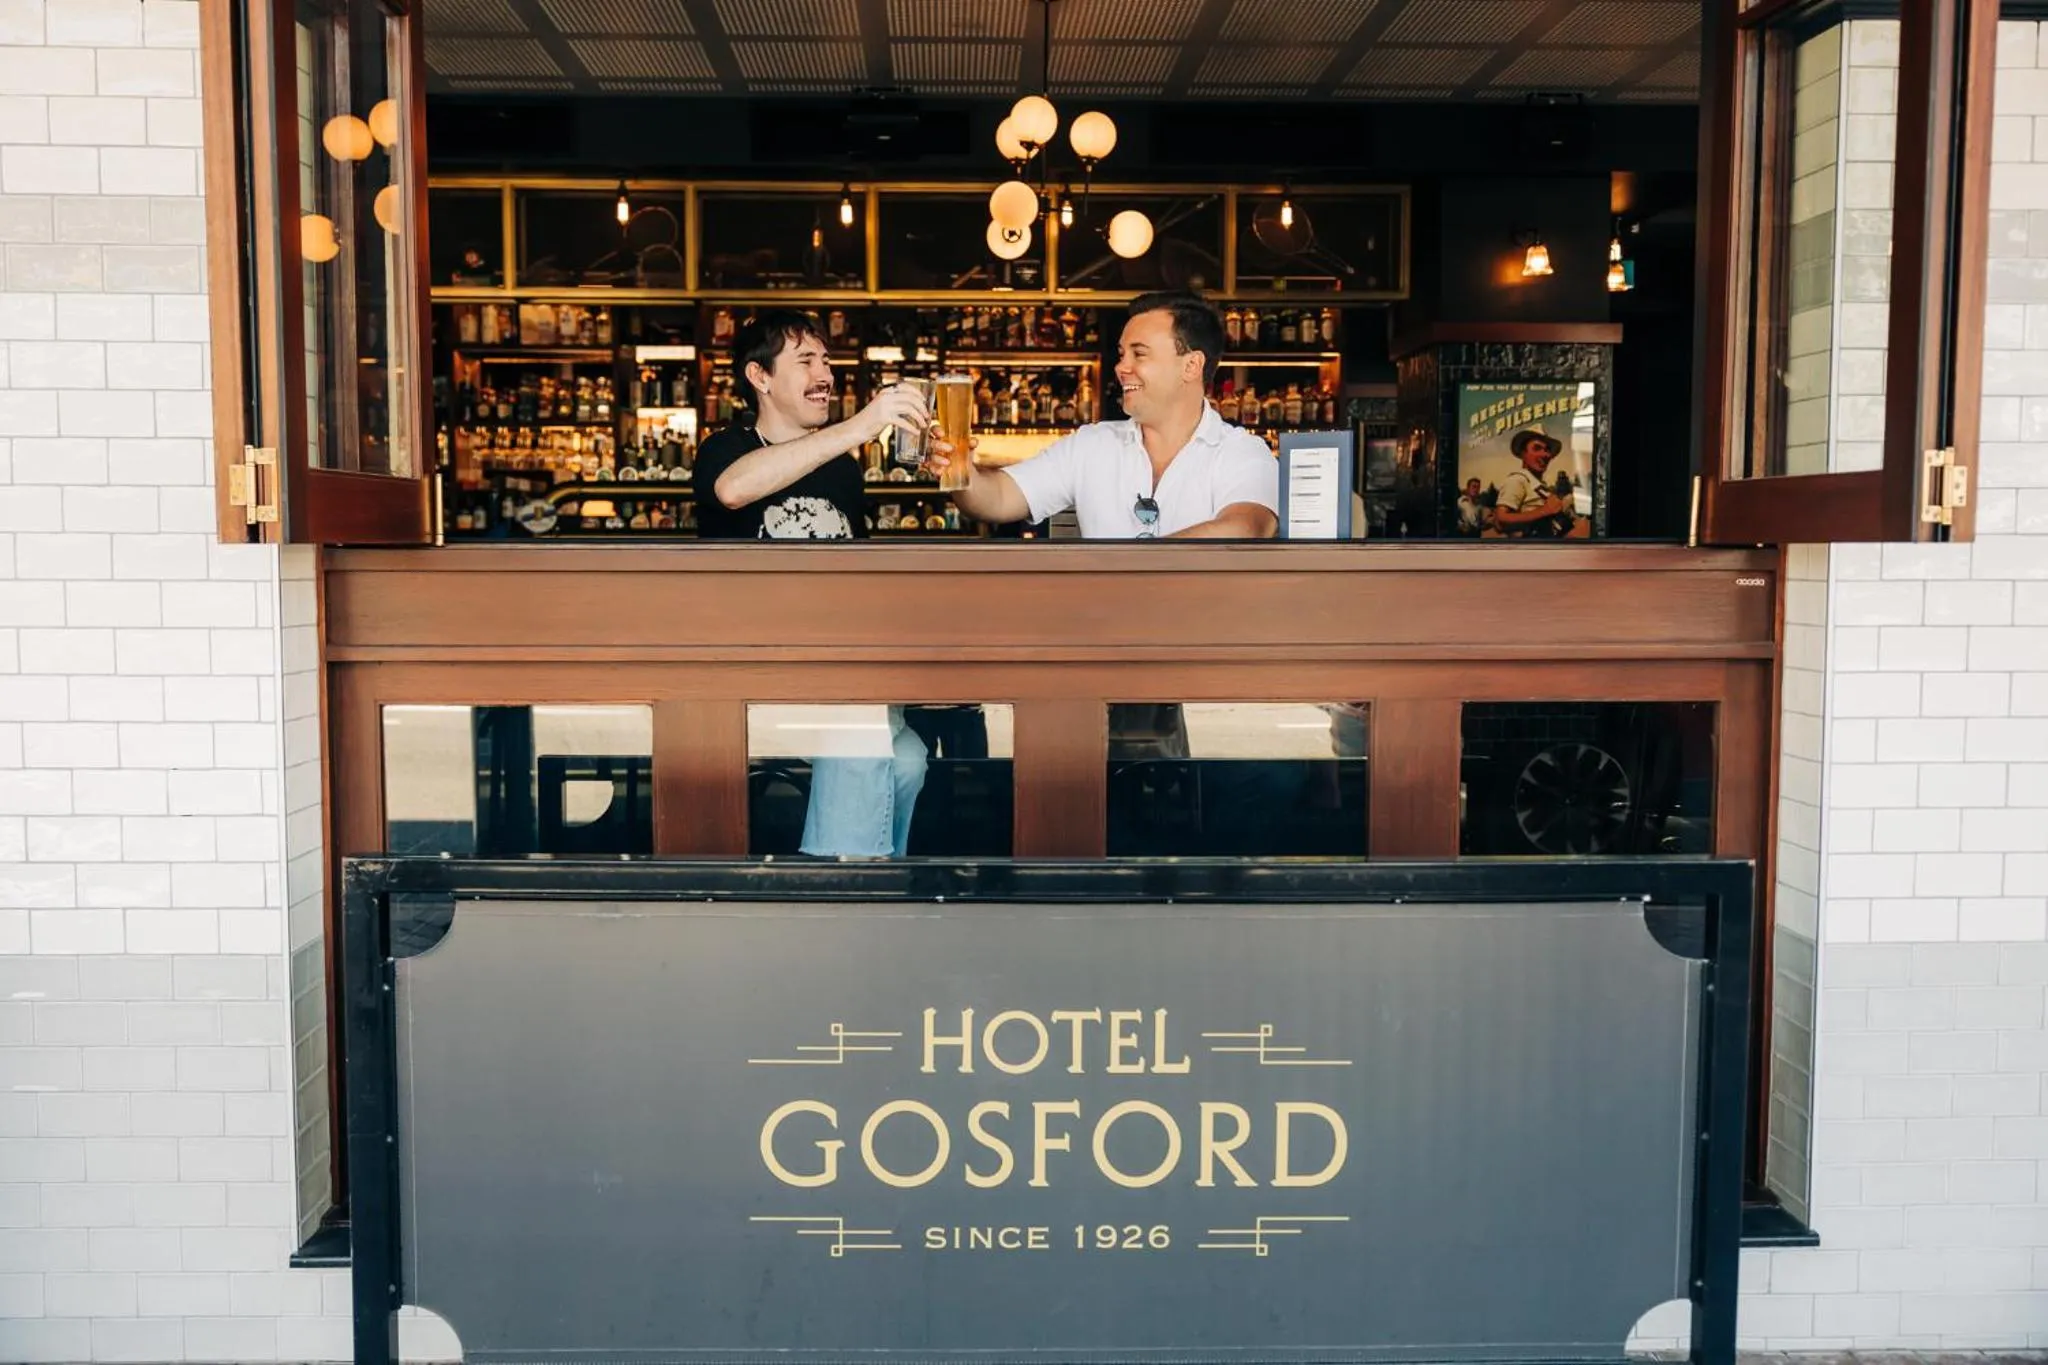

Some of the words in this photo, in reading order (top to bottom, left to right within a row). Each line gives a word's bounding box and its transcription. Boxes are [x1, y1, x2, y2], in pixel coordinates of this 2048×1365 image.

[920, 1006, 1191, 1075] HOTEL
[759, 1098, 1348, 1188] GOSFORD
[925, 1226, 1050, 1249] SINCE
[1074, 1225, 1171, 1250] 1926
